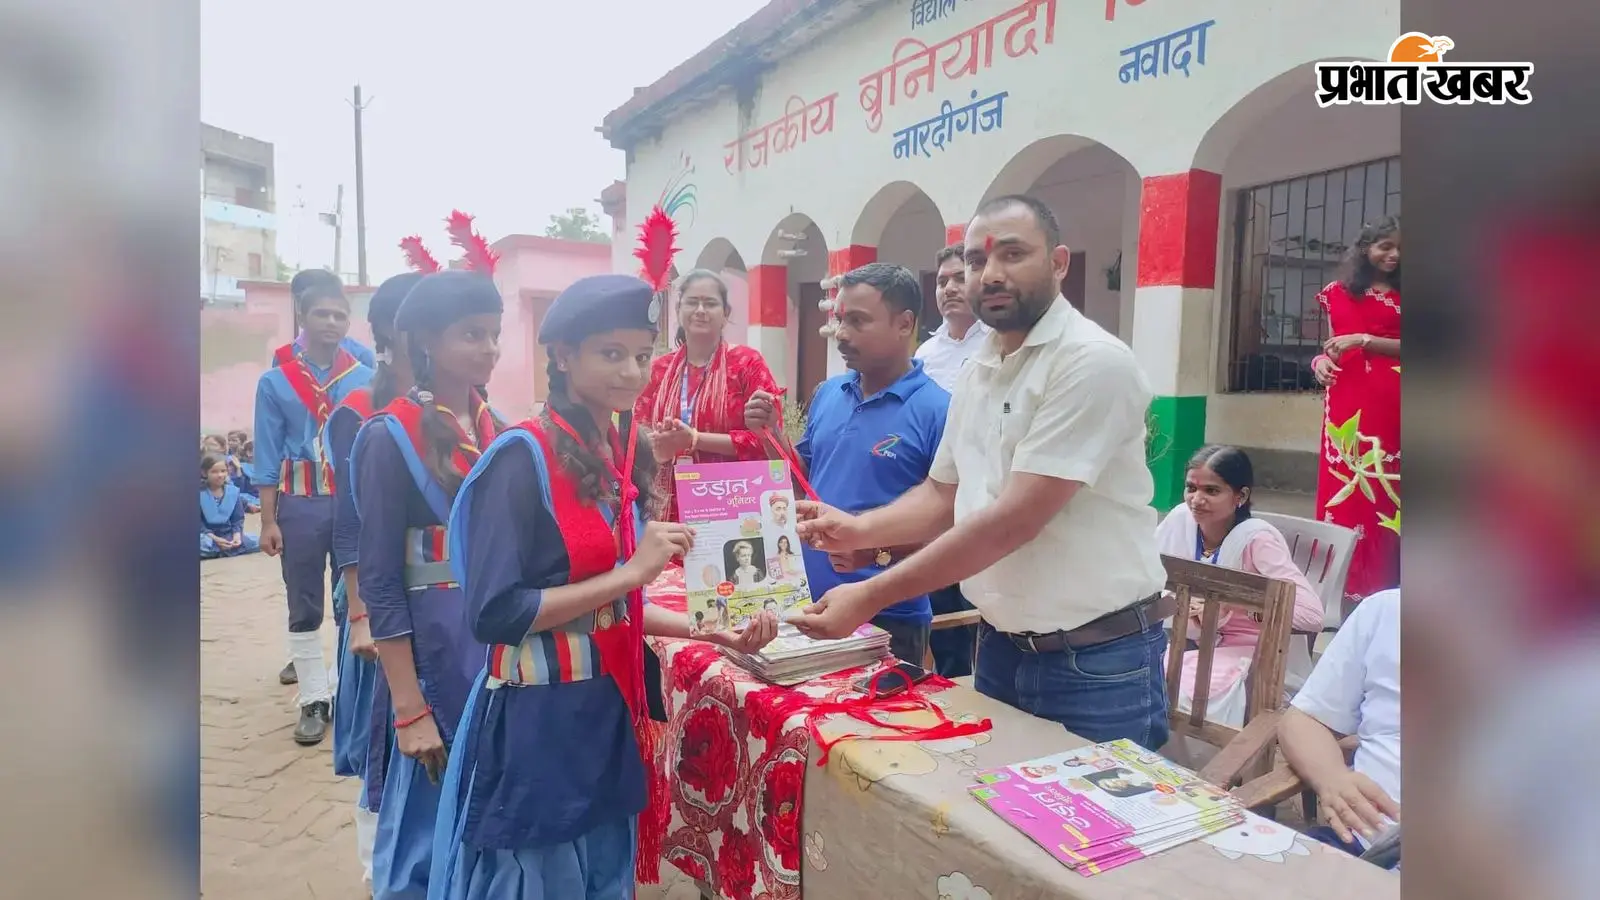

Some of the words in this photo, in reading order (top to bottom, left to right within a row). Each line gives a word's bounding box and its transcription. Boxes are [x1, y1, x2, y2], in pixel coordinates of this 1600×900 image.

[724, 94, 839, 175] राजकीय
[892, 90, 1009, 160] नारदीगंज
[1119, 20, 1216, 84] नवादा
